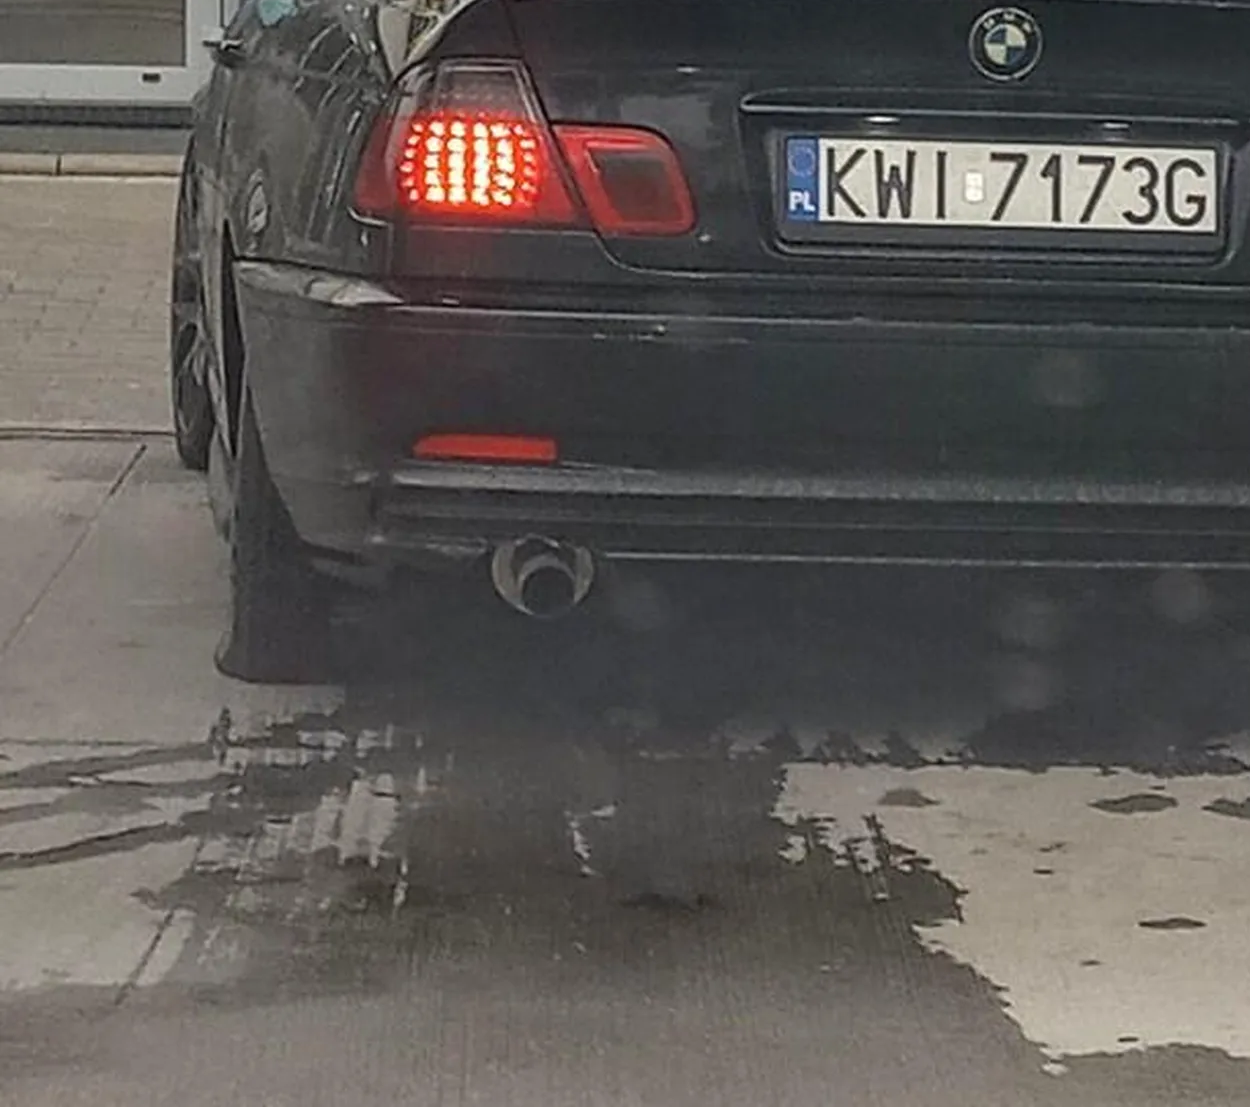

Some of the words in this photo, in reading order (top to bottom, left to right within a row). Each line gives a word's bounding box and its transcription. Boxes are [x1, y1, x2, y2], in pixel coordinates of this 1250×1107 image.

[788, 190, 815, 212] PL
[826, 147, 947, 220] KWI
[990, 152, 1206, 226] 7173G
